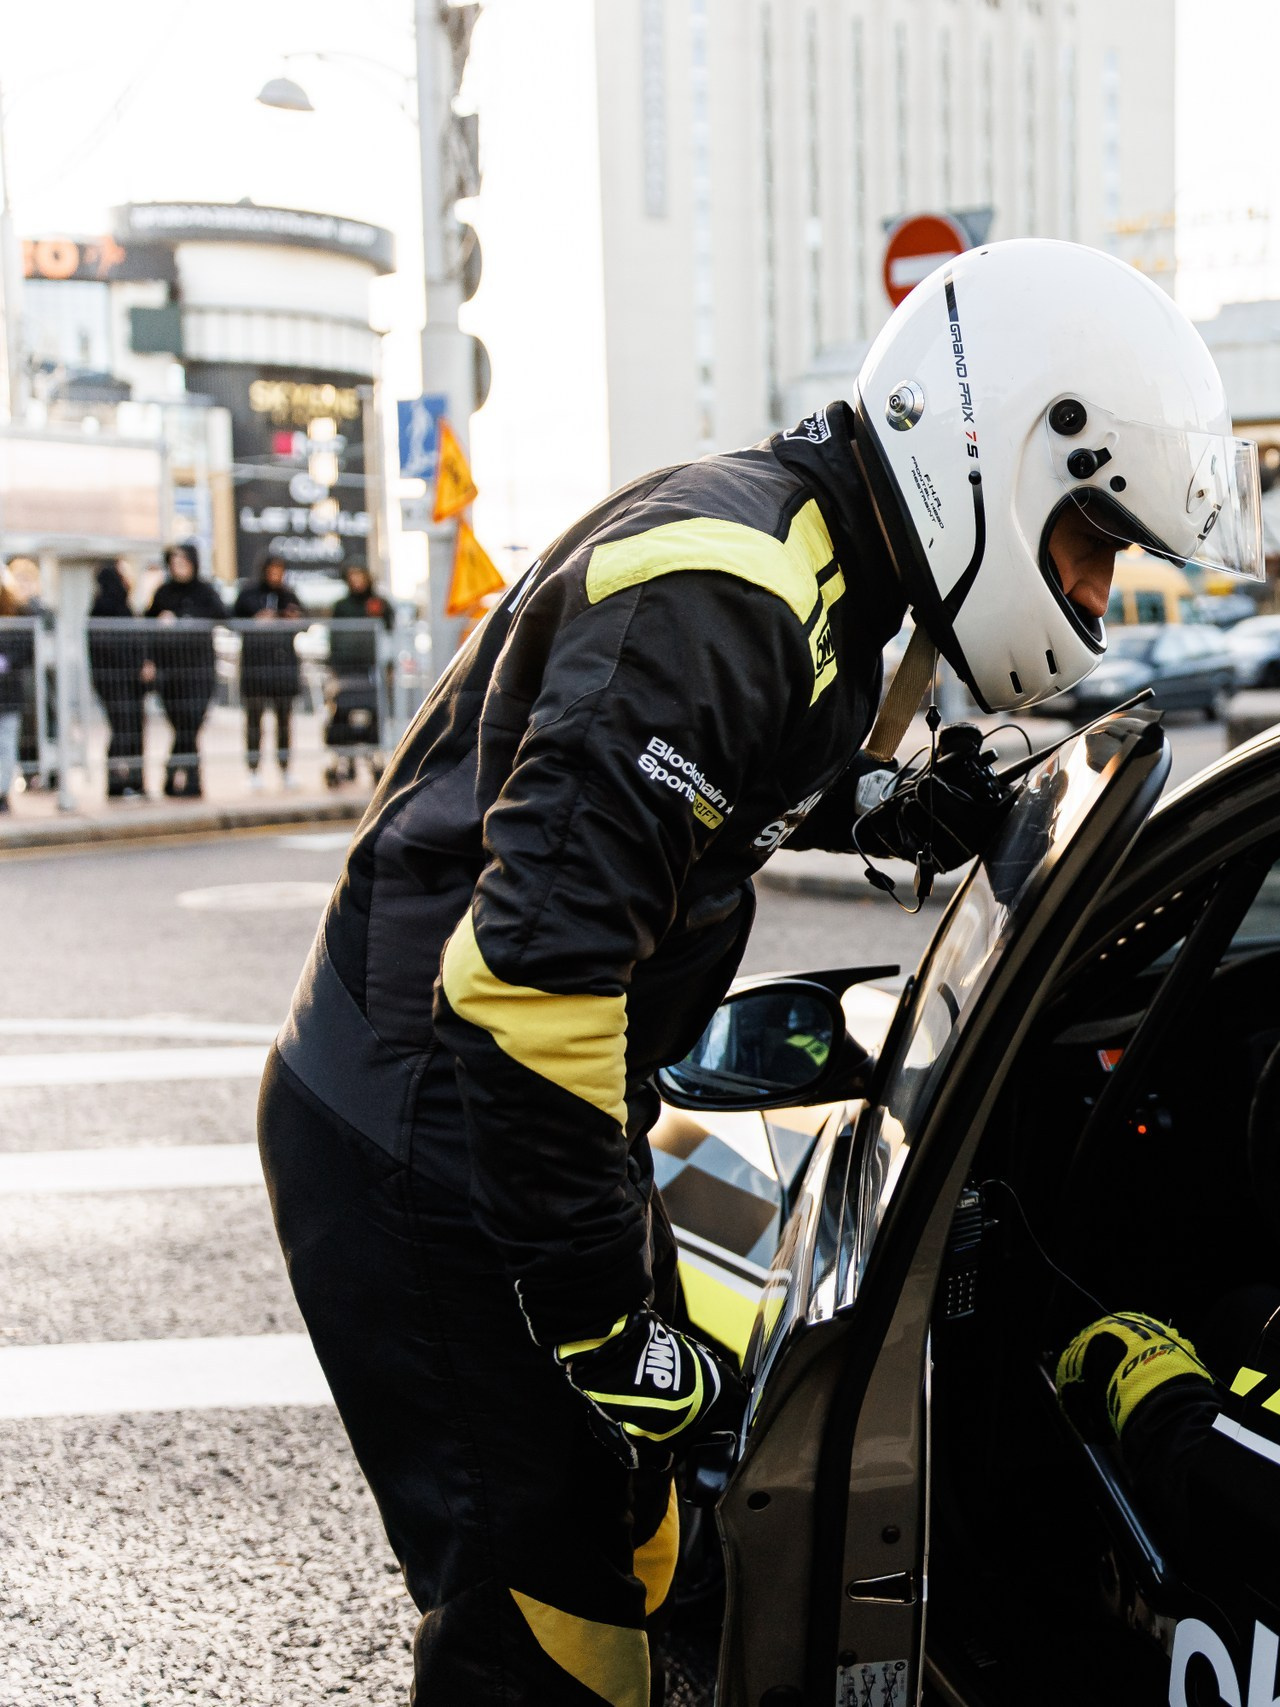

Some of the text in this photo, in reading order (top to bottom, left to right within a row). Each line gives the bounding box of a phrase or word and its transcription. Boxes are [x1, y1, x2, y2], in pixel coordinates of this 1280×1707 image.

[958, 382, 975, 424] PRIX
[638, 753, 697, 803] Sports
[646, 736, 728, 809] Blockchain
[645, 1322, 675, 1390] OMP
